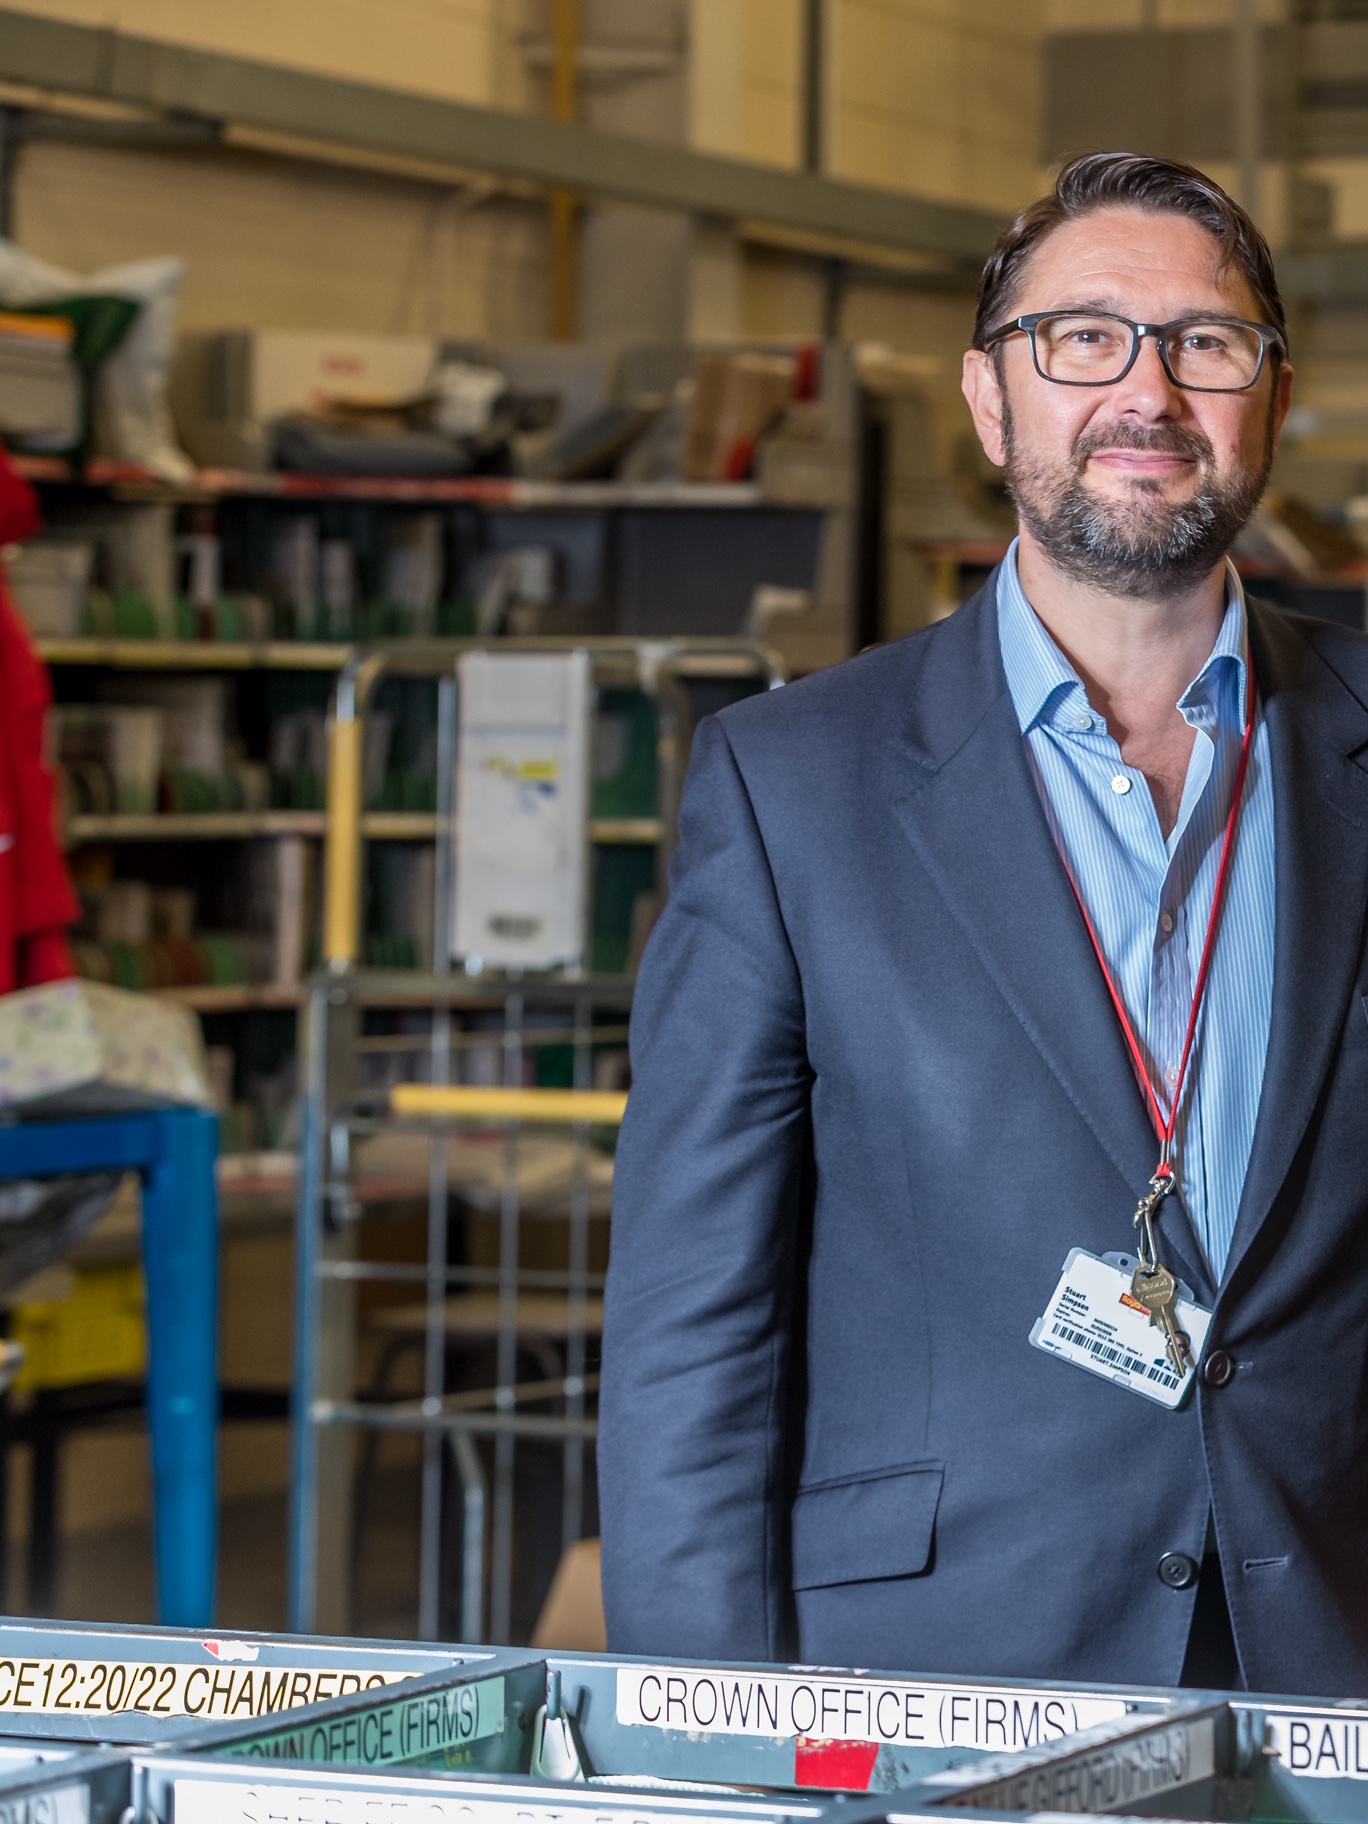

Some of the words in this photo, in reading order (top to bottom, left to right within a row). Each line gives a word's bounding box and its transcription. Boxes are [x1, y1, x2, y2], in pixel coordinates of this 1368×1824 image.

[1061, 1294, 1090, 1312] Simpson
[1064, 1286, 1087, 1301] Stuart
[401, 1685, 480, 1757] (FIRMS)
[639, 1675, 778, 1729] CROWN
[791, 1685, 925, 1739] OFFICE
